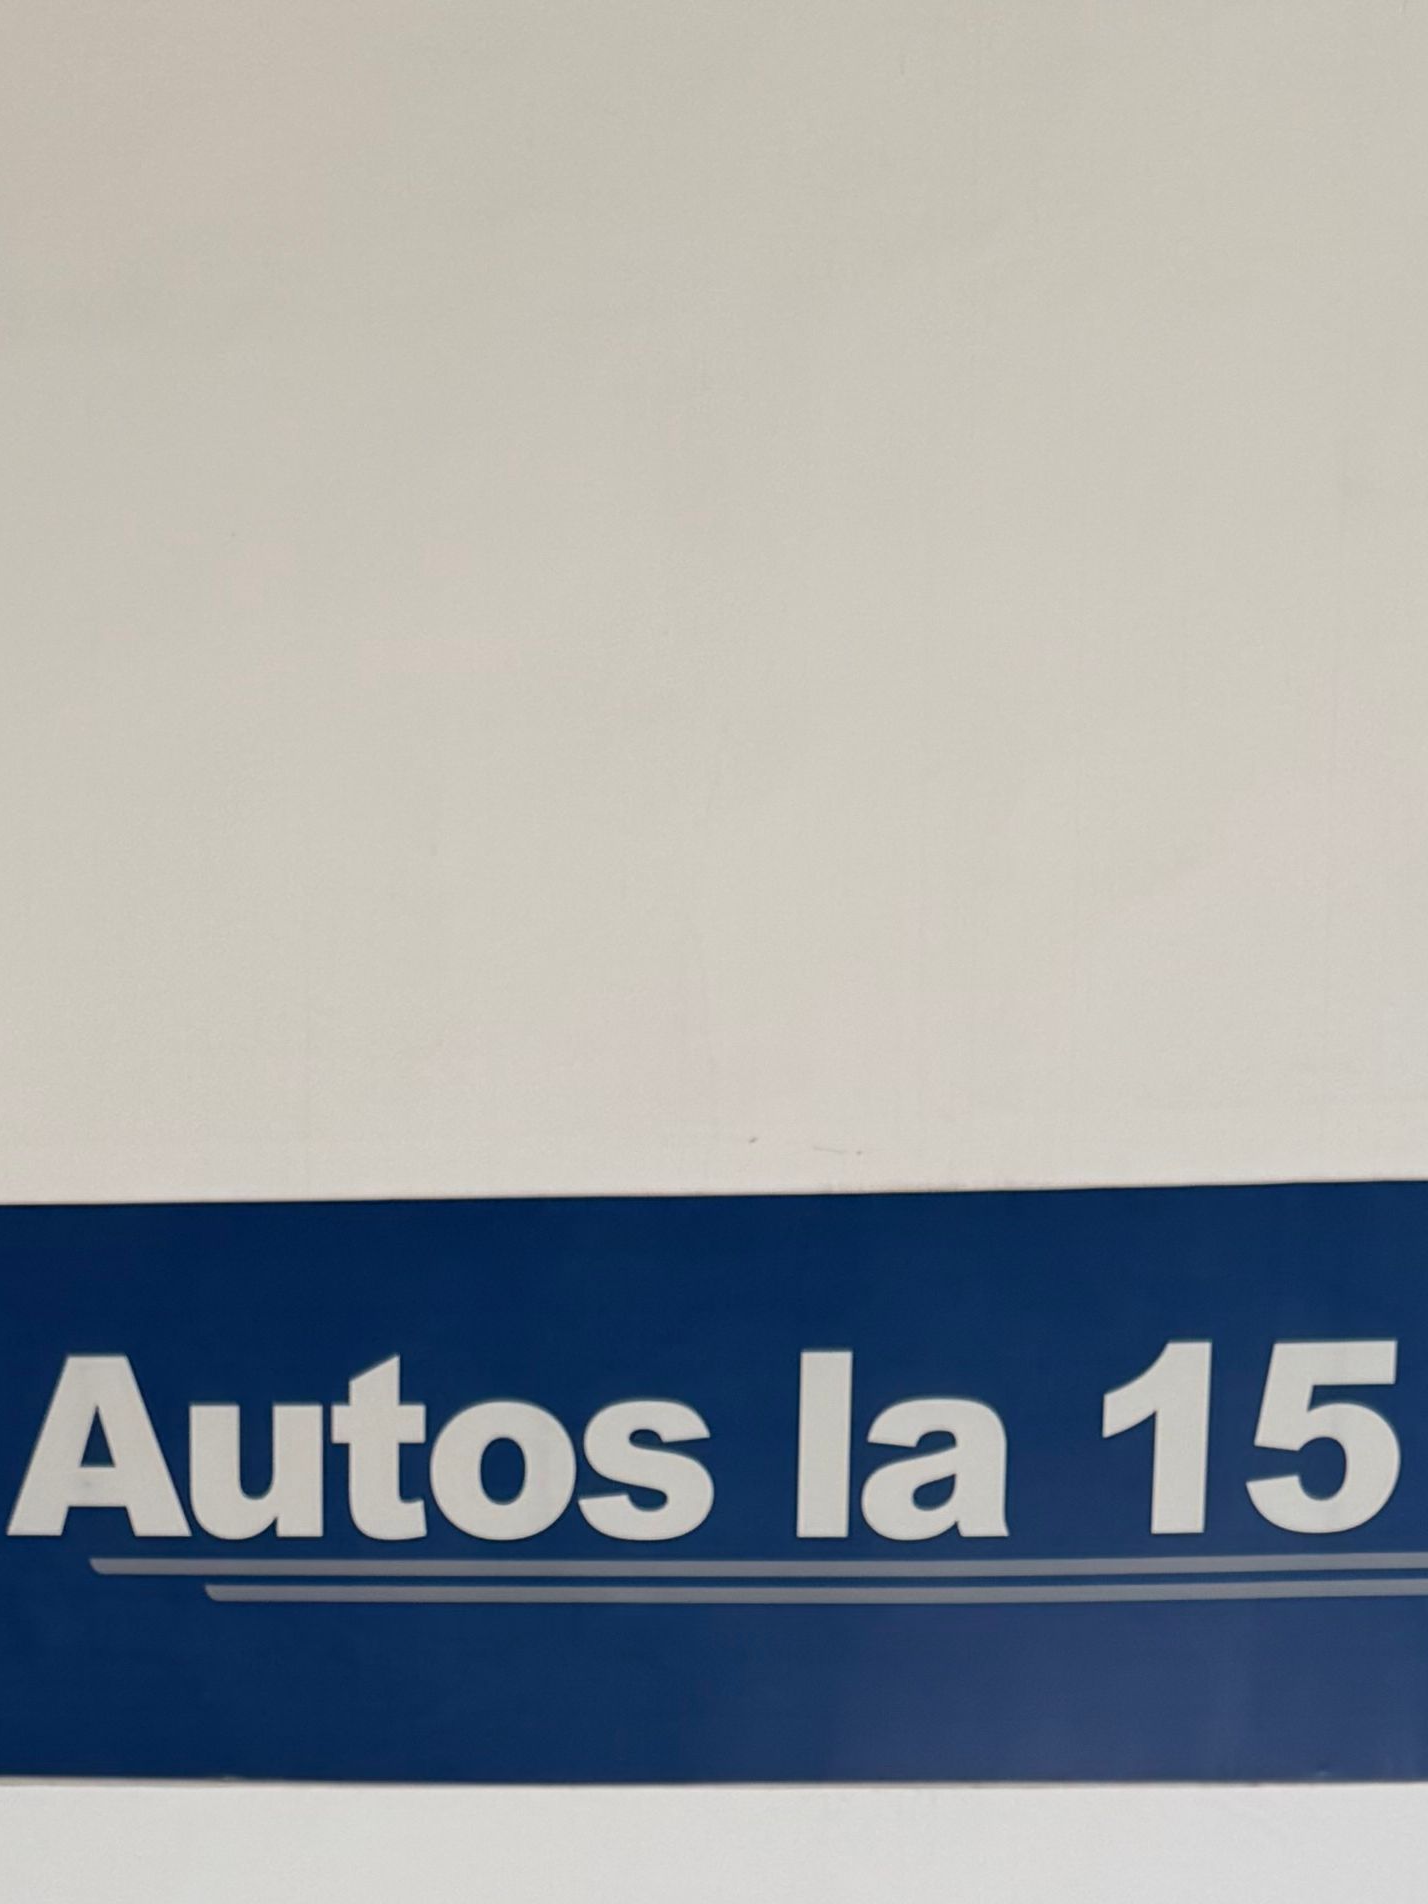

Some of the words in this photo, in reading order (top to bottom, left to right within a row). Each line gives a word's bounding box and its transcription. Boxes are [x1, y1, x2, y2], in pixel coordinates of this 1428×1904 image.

[8, 1356, 713, 1540] Autos
[797, 1351, 1008, 1540] la
[1103, 1341, 1400, 1534] 15
